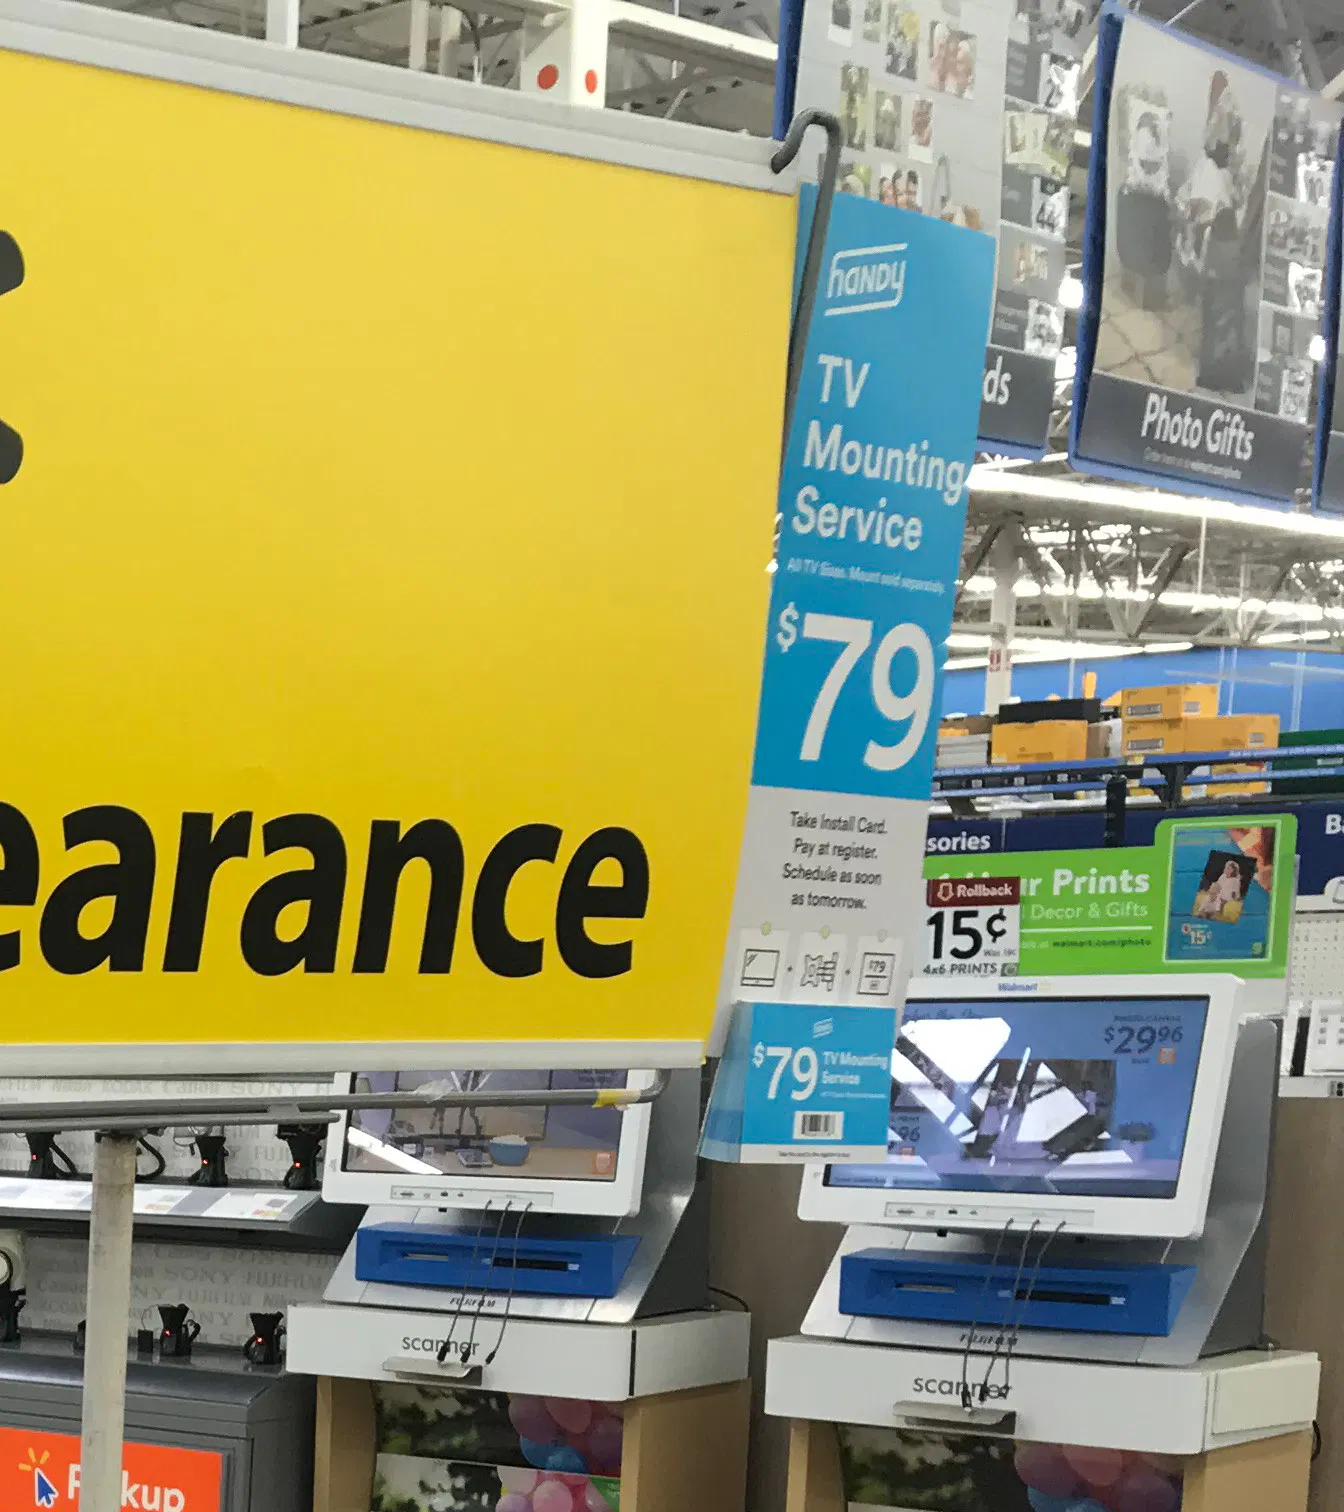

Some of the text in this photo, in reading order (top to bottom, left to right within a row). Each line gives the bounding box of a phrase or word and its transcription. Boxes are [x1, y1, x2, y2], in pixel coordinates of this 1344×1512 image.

[816, 352, 871, 408] TV
[1140, 394, 1255, 462] Photo Gifts
[803, 420, 965, 505] Mounting
[792, 485, 923, 551] Service
[777, 601, 936, 772] $79
[790, 811, 888, 834] Take Install Card.
[793, 837, 830, 858] Pay at
[925, 831, 991, 854] sories
[782, 862, 837, 882] Schedule
[1053, 867, 1151, 896] Prints
[956, 883, 1013, 898] Rollback
[1031, 900, 1149, 921] Decor Gifts
[926, 908, 1008, 960] 15¢
[923, 962, 998, 976] 4x6 PRINTS
[752, 1041, 818, 1101] $79
[401, 1332, 481, 1358] scanner
[912, 1374, 1013, 1400] scanner
